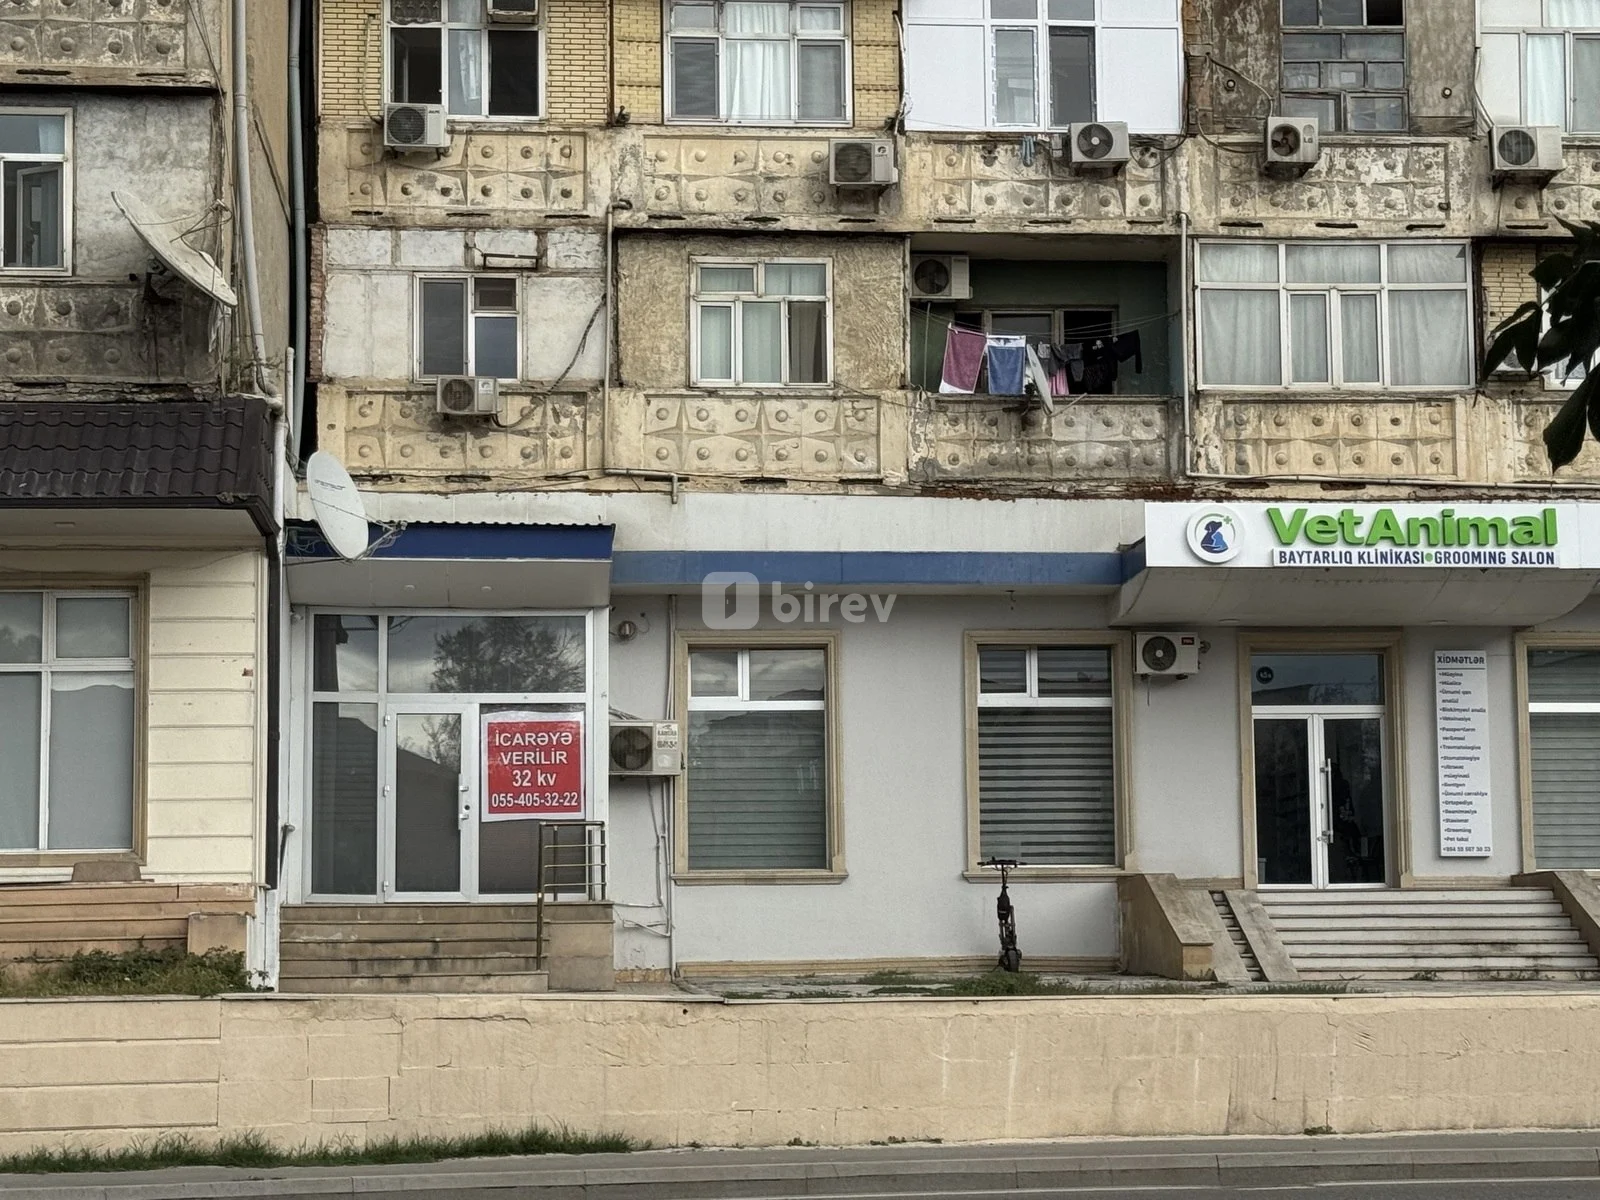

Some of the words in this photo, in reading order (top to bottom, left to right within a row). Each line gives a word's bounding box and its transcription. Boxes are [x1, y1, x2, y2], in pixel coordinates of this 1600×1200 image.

[1266, 507, 1558, 546] VetAnimal
[1279, 551, 1353, 565] BAYTARLIQ
[1434, 551, 1506, 565] GROOMING
[1511, 551, 1555, 565] SALON
[1437, 653, 1485, 664] XİDMƏTLƏR
[495, 729, 573, 746] İCARƏYƏ
[500, 748, 568, 765] VERİLİR
[512, 769, 532, 787] 32
[537, 769, 557, 786] kv
[491, 792, 578, 807] 055-405-32-22
